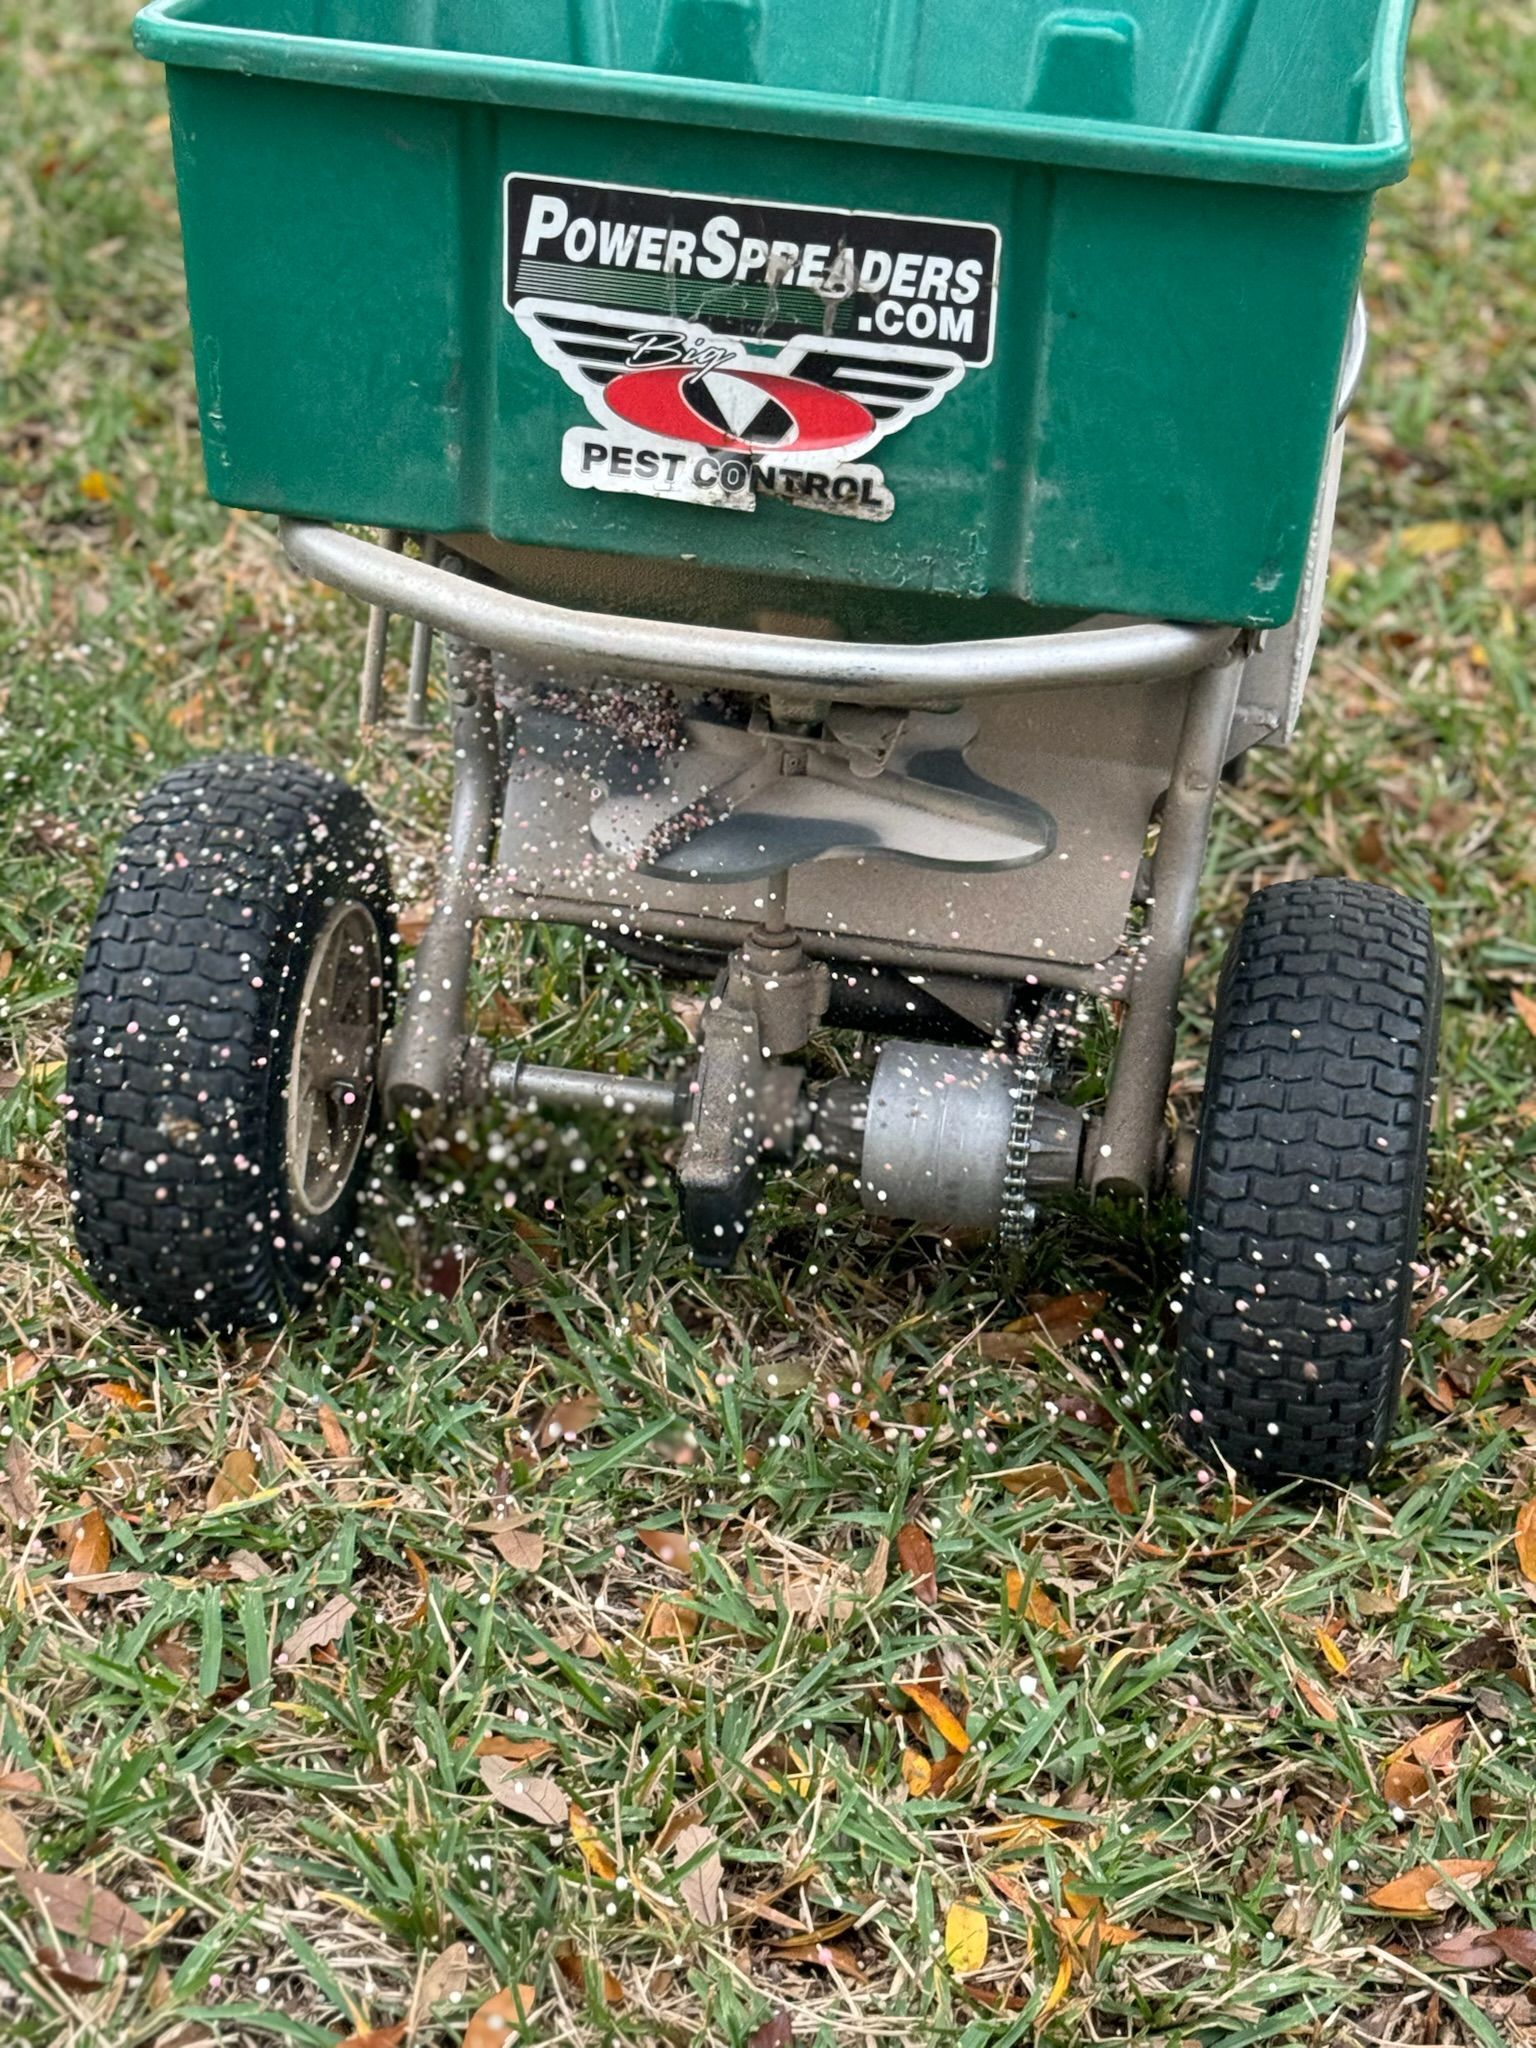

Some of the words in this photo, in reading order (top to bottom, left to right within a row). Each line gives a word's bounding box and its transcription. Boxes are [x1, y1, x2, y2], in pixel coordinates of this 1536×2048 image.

[857, 300, 974, 343] .COM
[625, 330, 737, 384] Big
[581, 442, 686, 482] PEST
[692, 457, 883, 507] CONTROL
